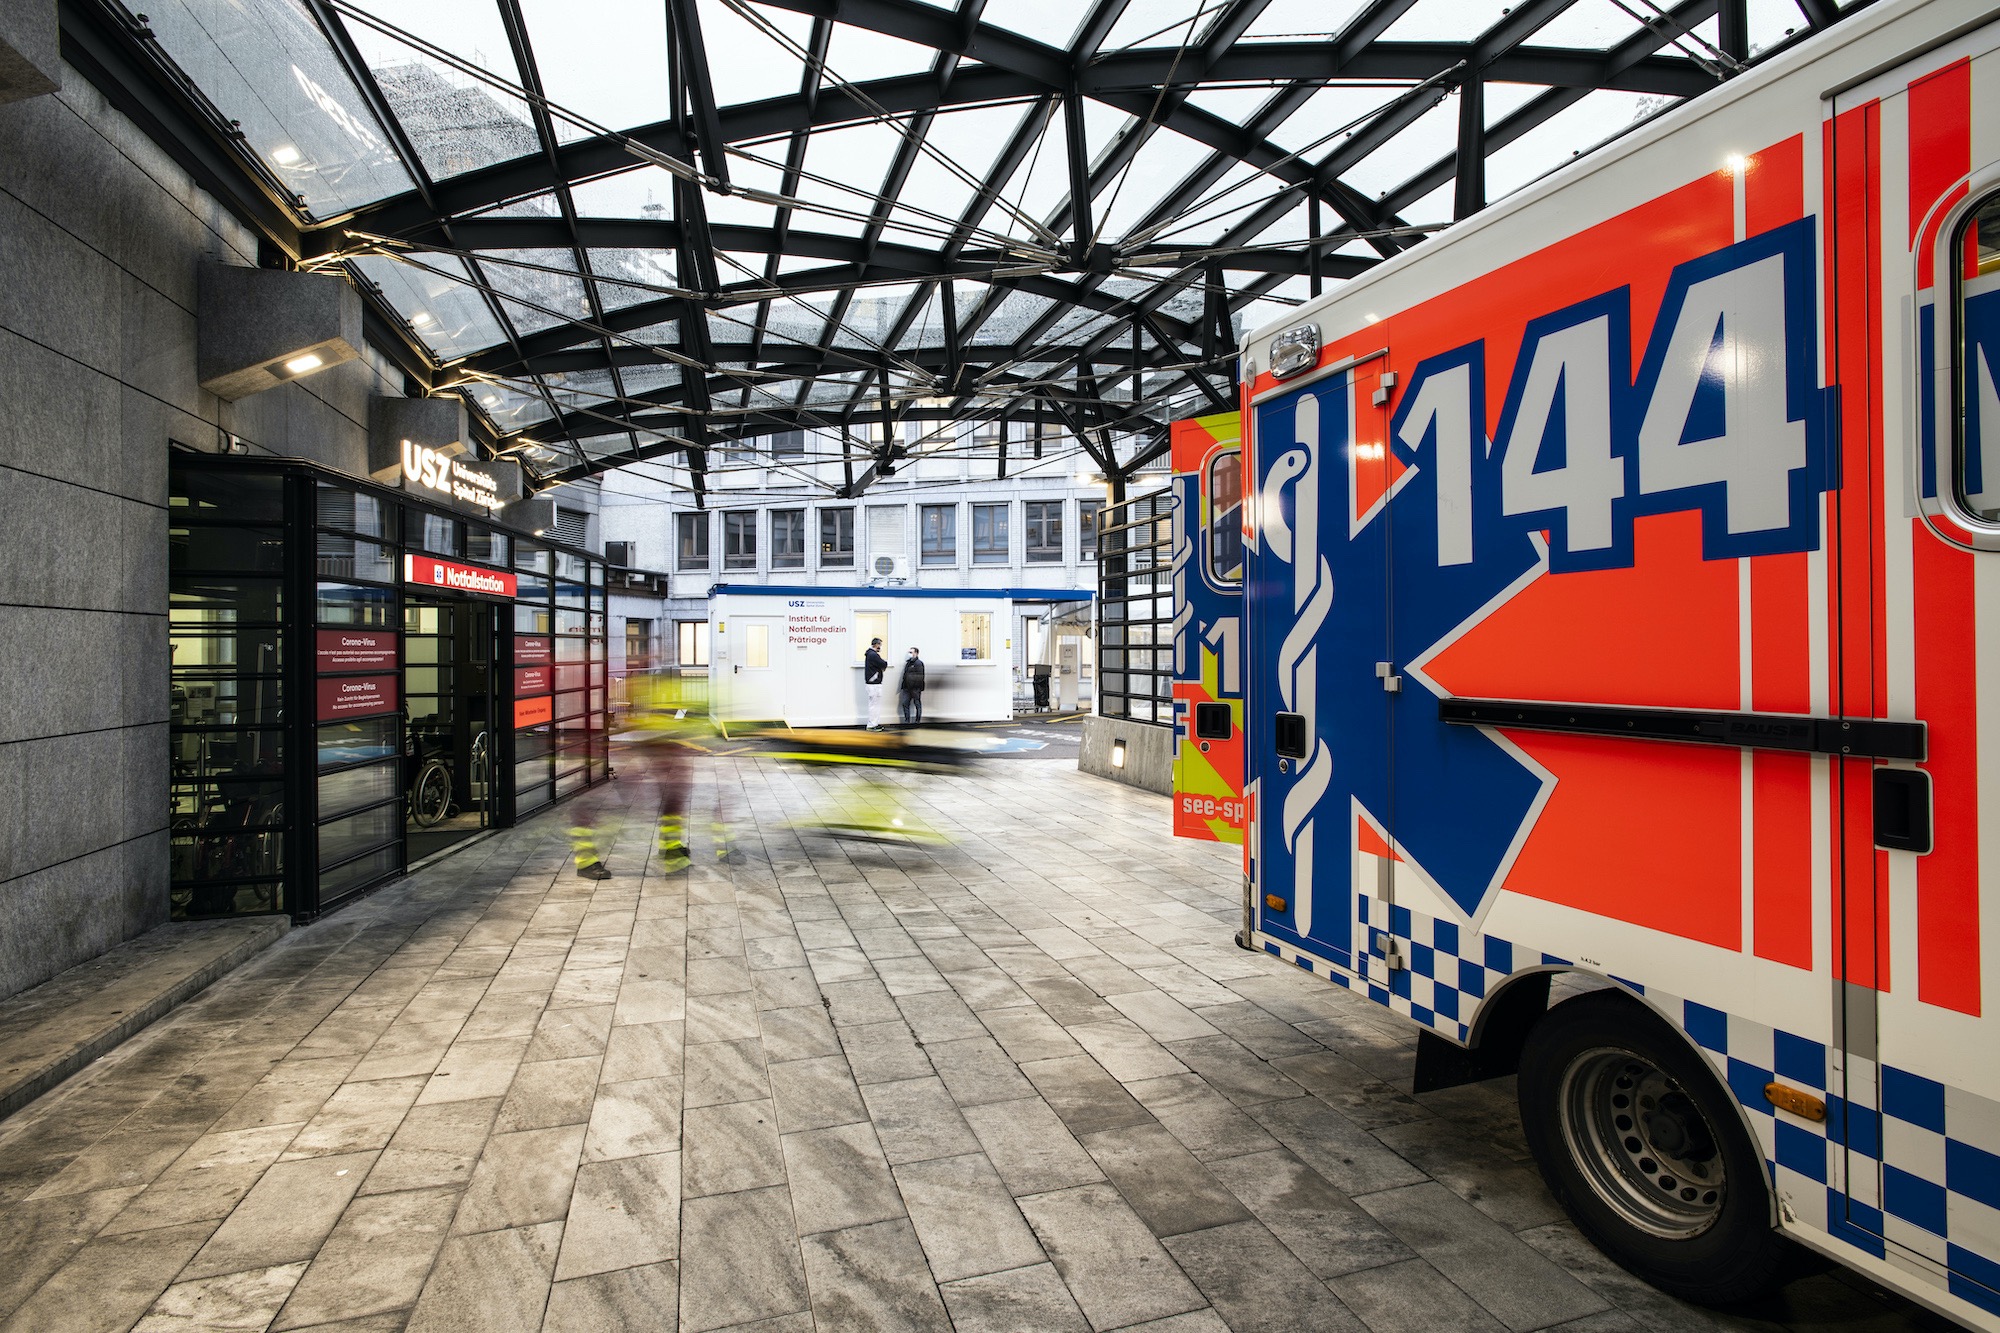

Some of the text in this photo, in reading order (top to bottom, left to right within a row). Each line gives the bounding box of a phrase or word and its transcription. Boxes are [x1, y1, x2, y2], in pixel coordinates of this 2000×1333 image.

[1397, 252, 1807, 568] 144
[402, 439, 452, 494] USZ
[446, 566, 505, 593] Notfallstation
[788, 600, 805, 608] USZ
[788, 614, 831, 623] Institut für
[788, 625, 847, 633] Notfallmedizin
[342, 637, 376, 646] Corona-Virus
[788, 635, 827, 645] Prätriage
[342, 683, 376, 692] Corona-Virus
